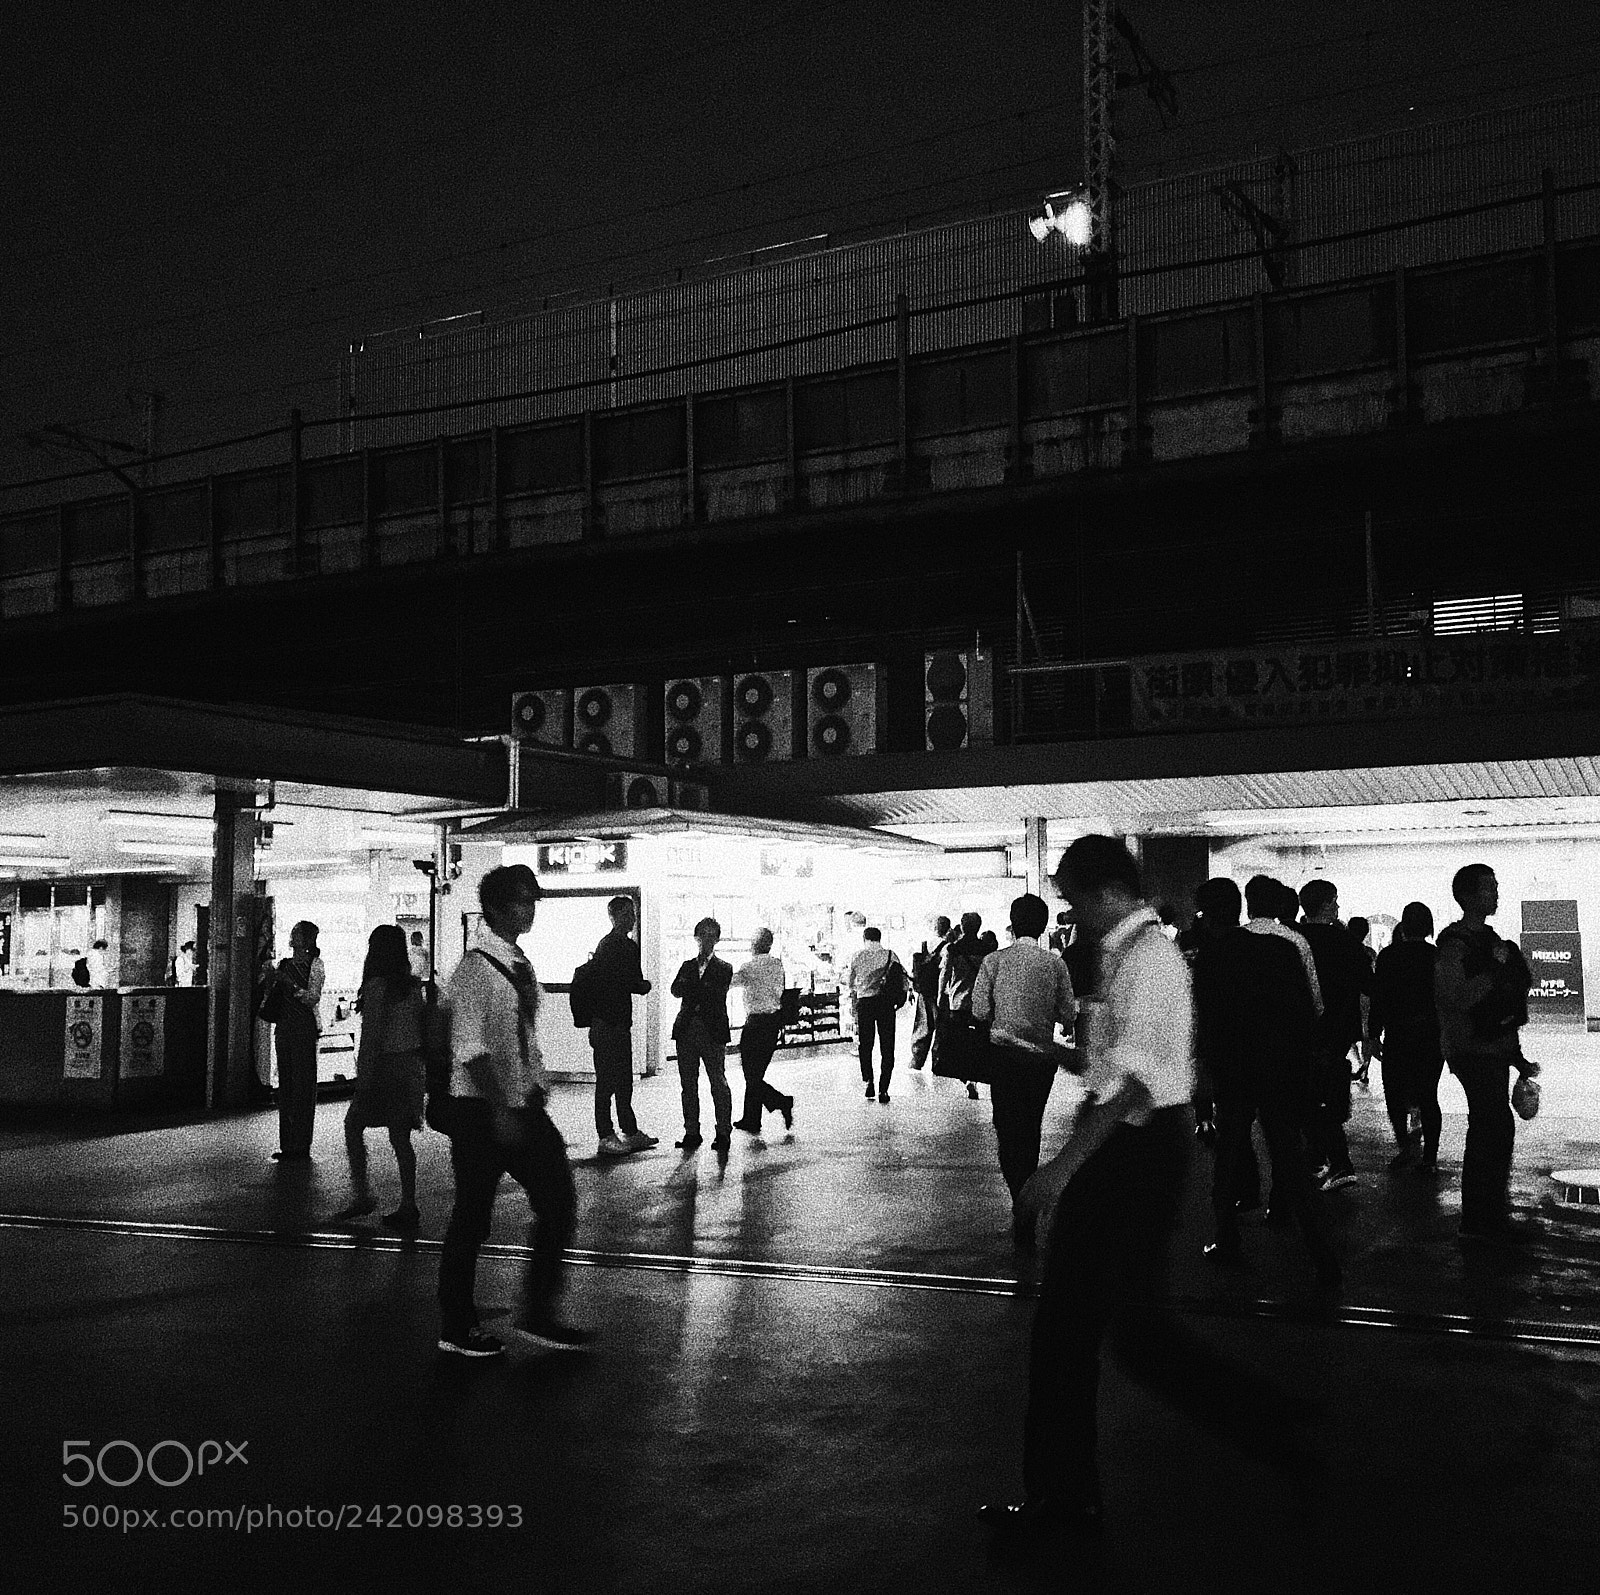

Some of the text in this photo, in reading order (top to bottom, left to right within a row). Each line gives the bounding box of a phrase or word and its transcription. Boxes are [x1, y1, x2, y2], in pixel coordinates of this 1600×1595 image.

[548, 844, 616, 866] KIOSK
[1528, 988, 1579, 997] ATMコーナー
